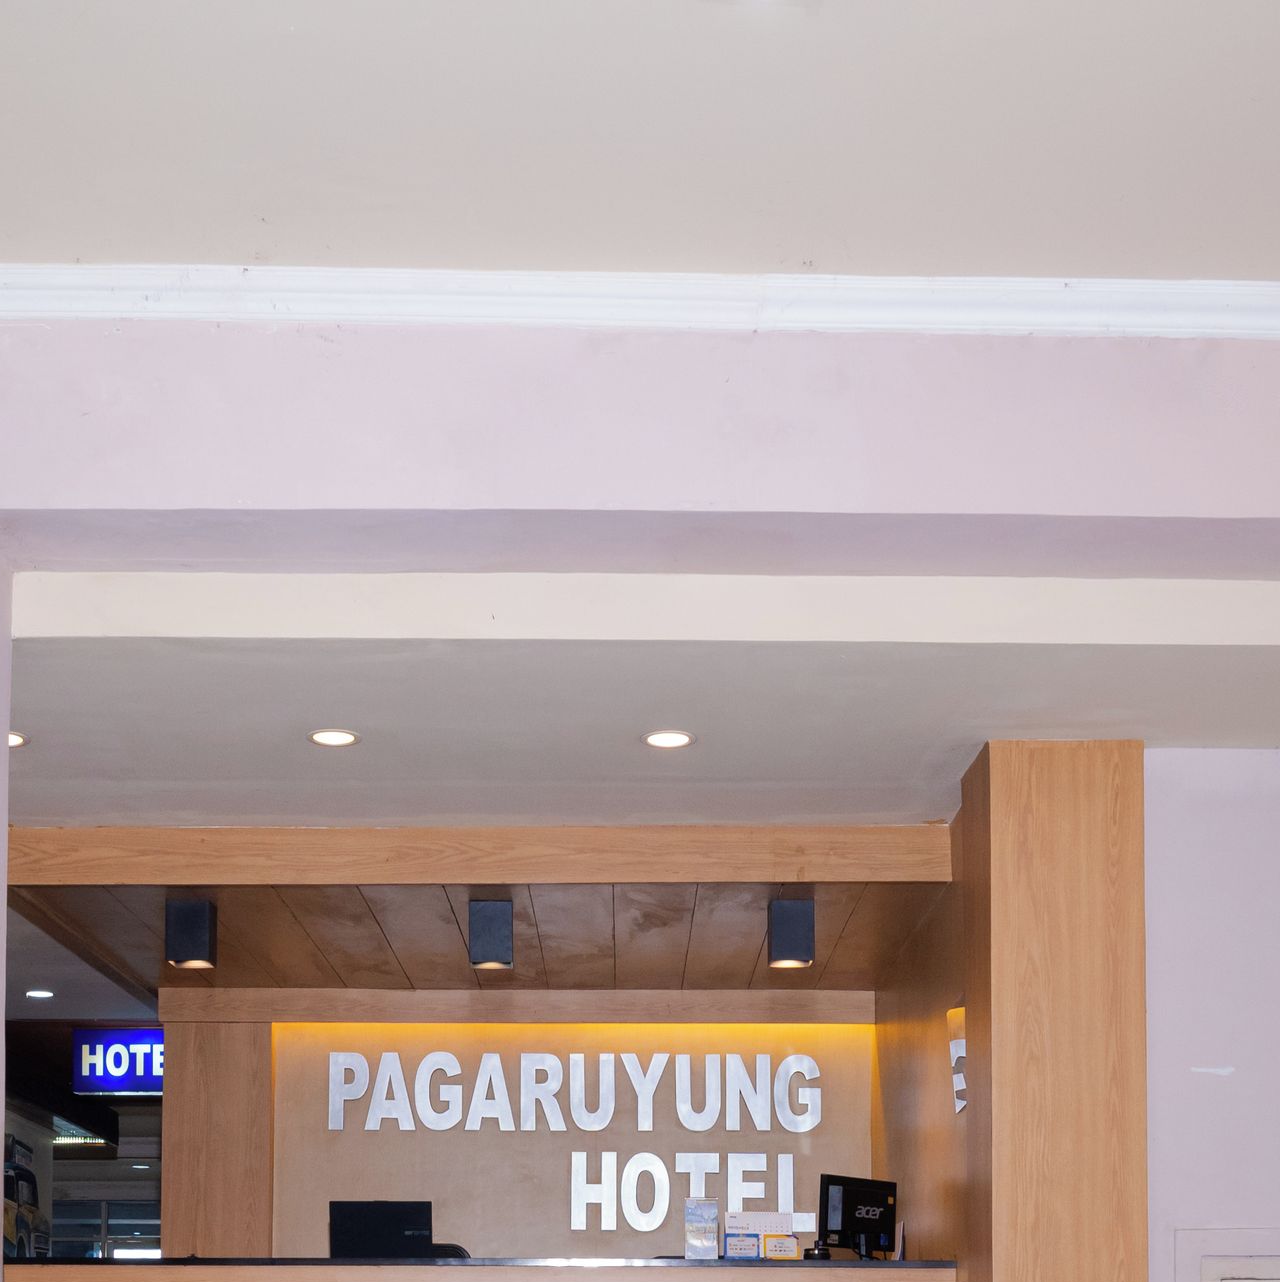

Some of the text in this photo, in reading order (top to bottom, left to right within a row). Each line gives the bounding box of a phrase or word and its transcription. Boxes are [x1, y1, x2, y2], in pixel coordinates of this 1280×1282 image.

[328, 1051, 822, 1133] PAGARUYUNG
[570, 1151, 817, 1232] HOTEL
[855, 1205, 884, 1220] acer
